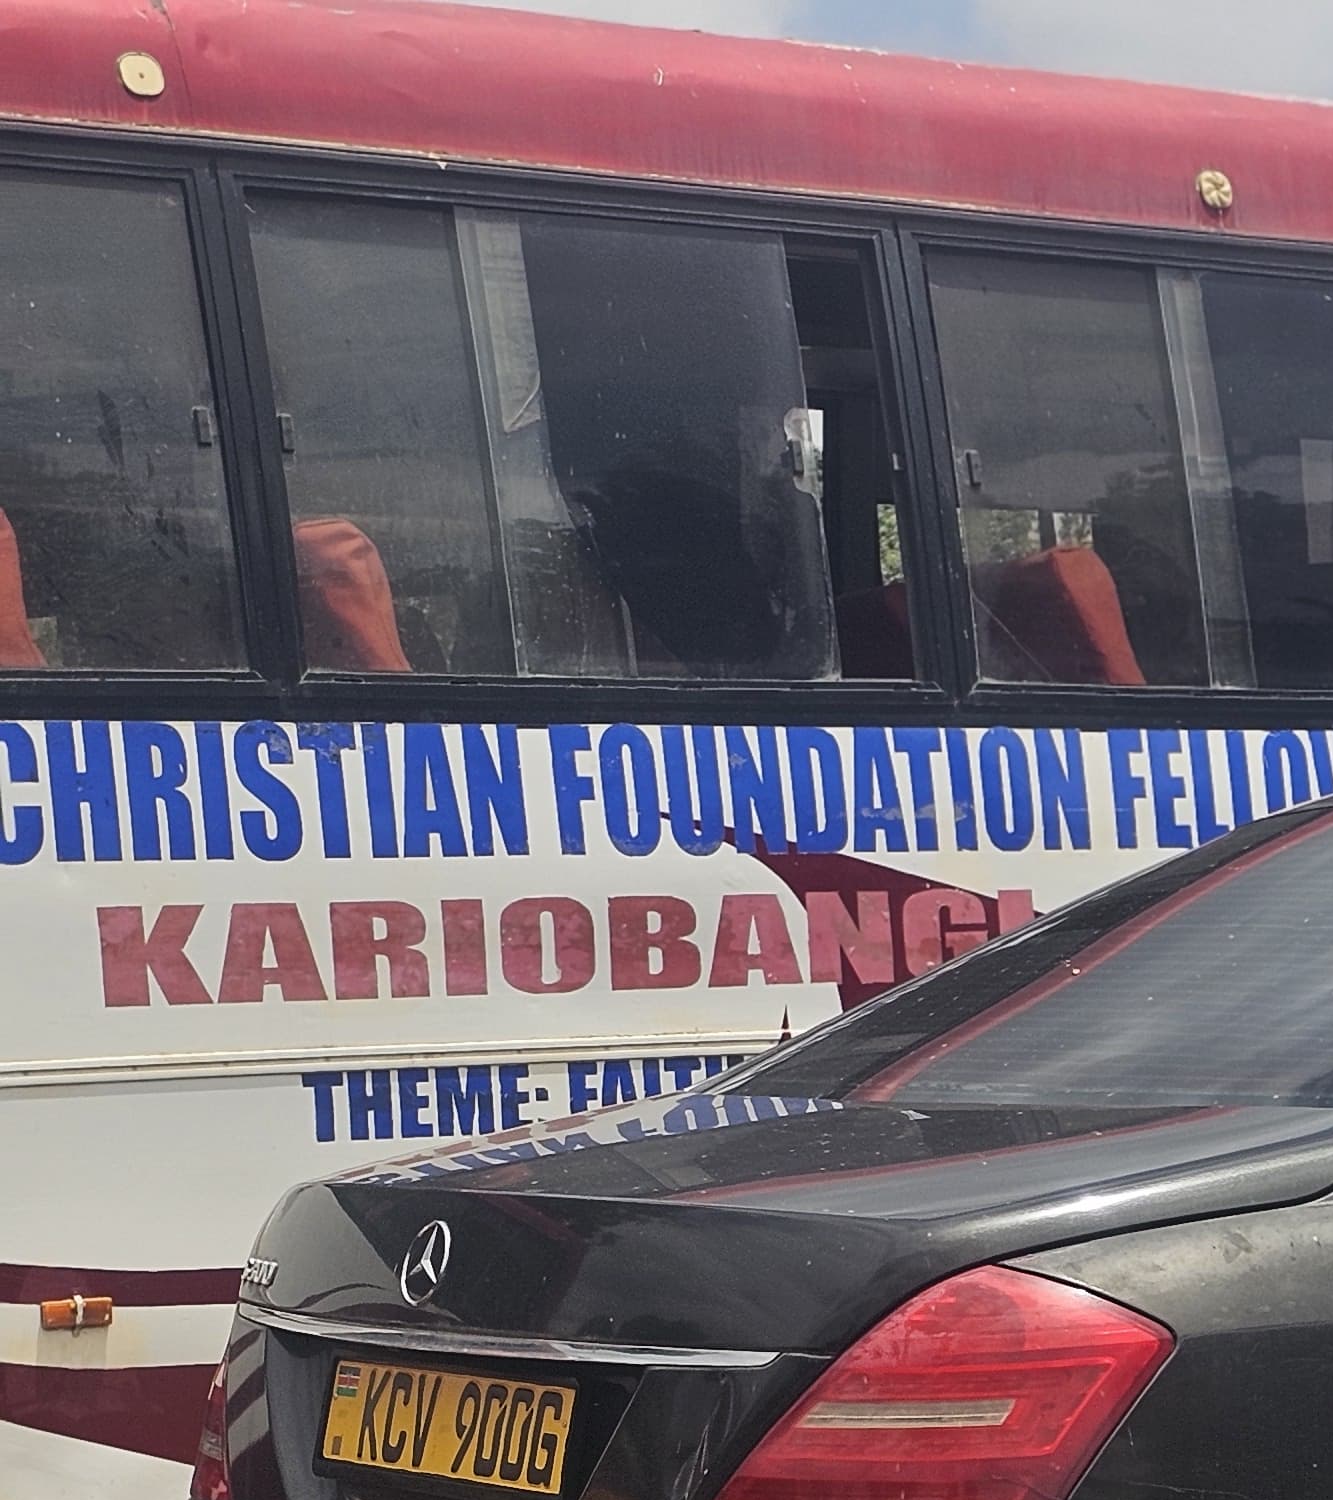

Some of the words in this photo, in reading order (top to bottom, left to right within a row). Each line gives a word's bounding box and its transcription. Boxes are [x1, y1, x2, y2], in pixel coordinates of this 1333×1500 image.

[0, 720, 529, 866] CHRISTIAN
[548, 724, 1092, 857] FOUNDATION
[356, 1369, 442, 1468] KCV
[450, 1380, 564, 1489] 900G
